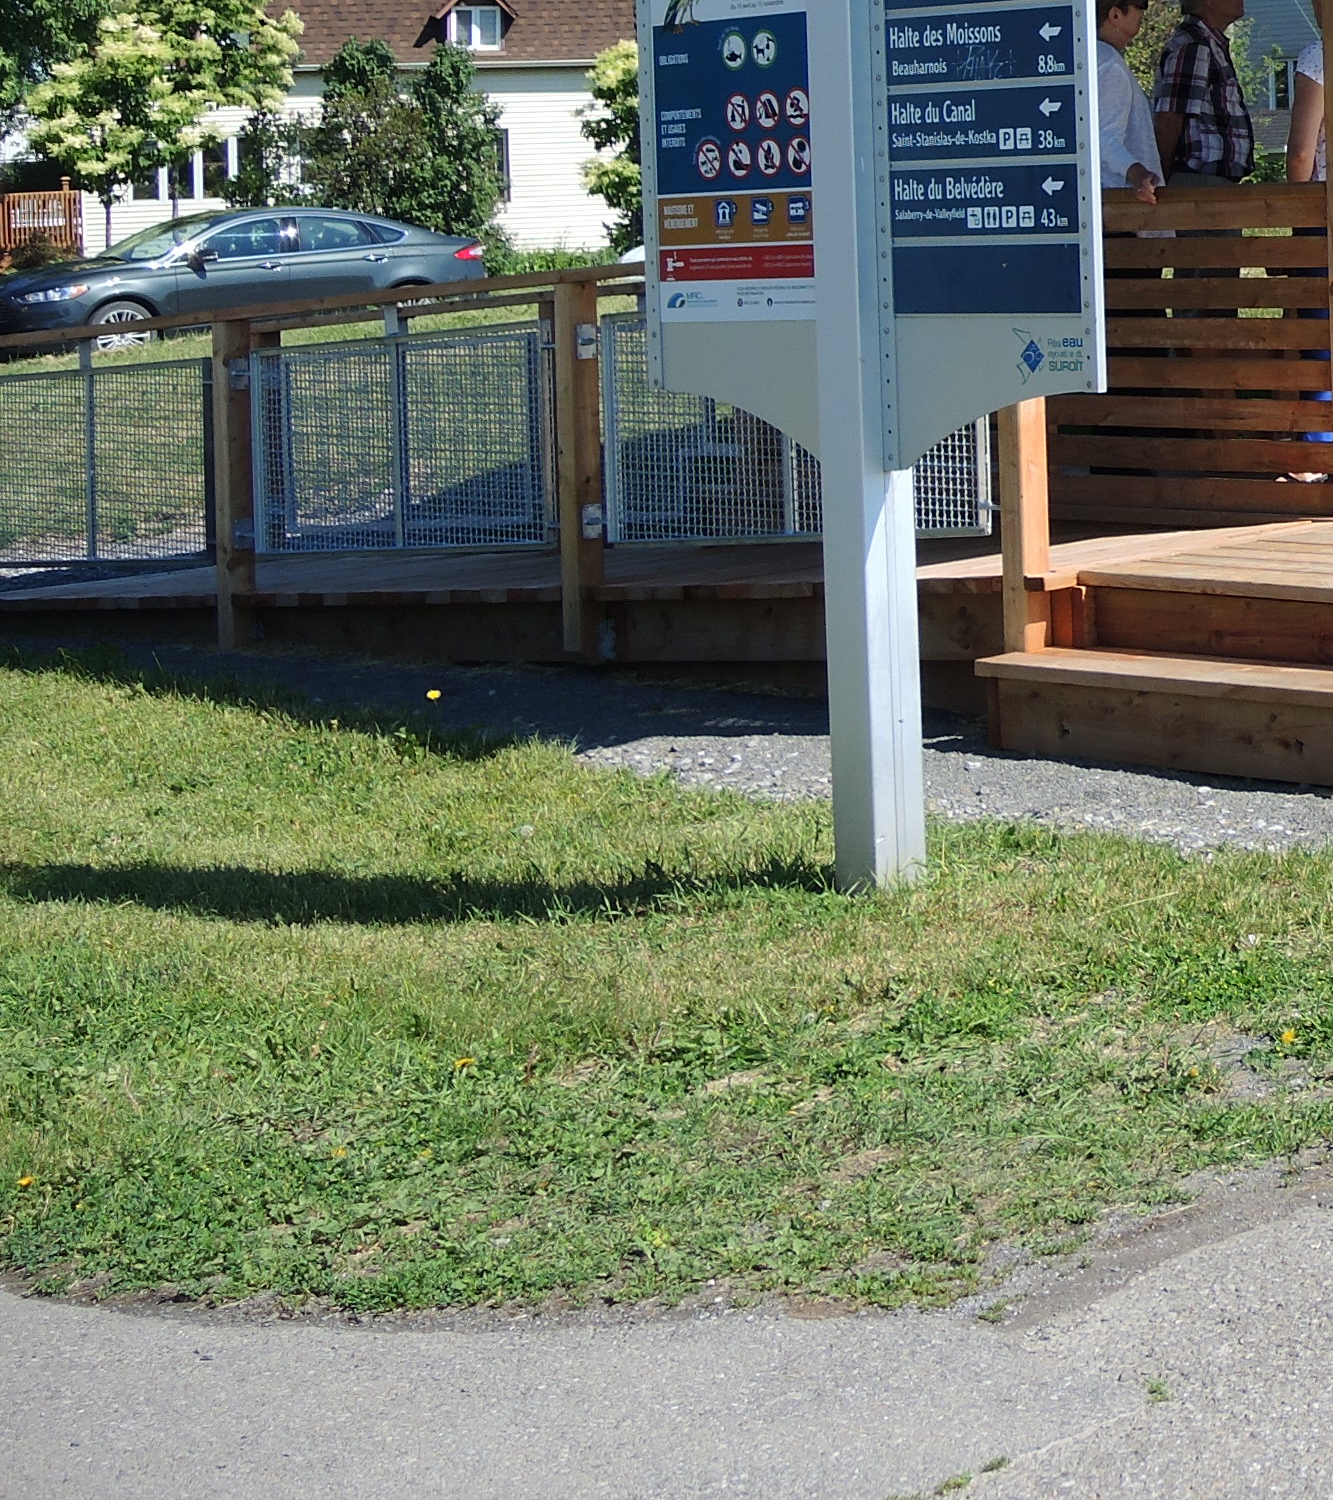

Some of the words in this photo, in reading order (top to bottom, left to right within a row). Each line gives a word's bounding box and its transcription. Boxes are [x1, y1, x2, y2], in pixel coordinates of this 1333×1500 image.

[889, 26, 920, 49] Halte
[924, 25, 943, 46] des
[947, 22, 1001, 45] Moissons
[892, 58, 947, 76] Beauharnois
[891, 102, 921, 124] Halte
[925, 101, 939, 123] du
[943, 99, 975, 122] Canal
[892, 129, 996, 148] Saint-Stanislas-de-Kostka
[894, 179, 924, 200] Halte
[928, 178, 942, 199] du
[946, 176, 1004, 199] Belvédère
[895, 208, 966, 222] Salaberry-de-Valleyfield
